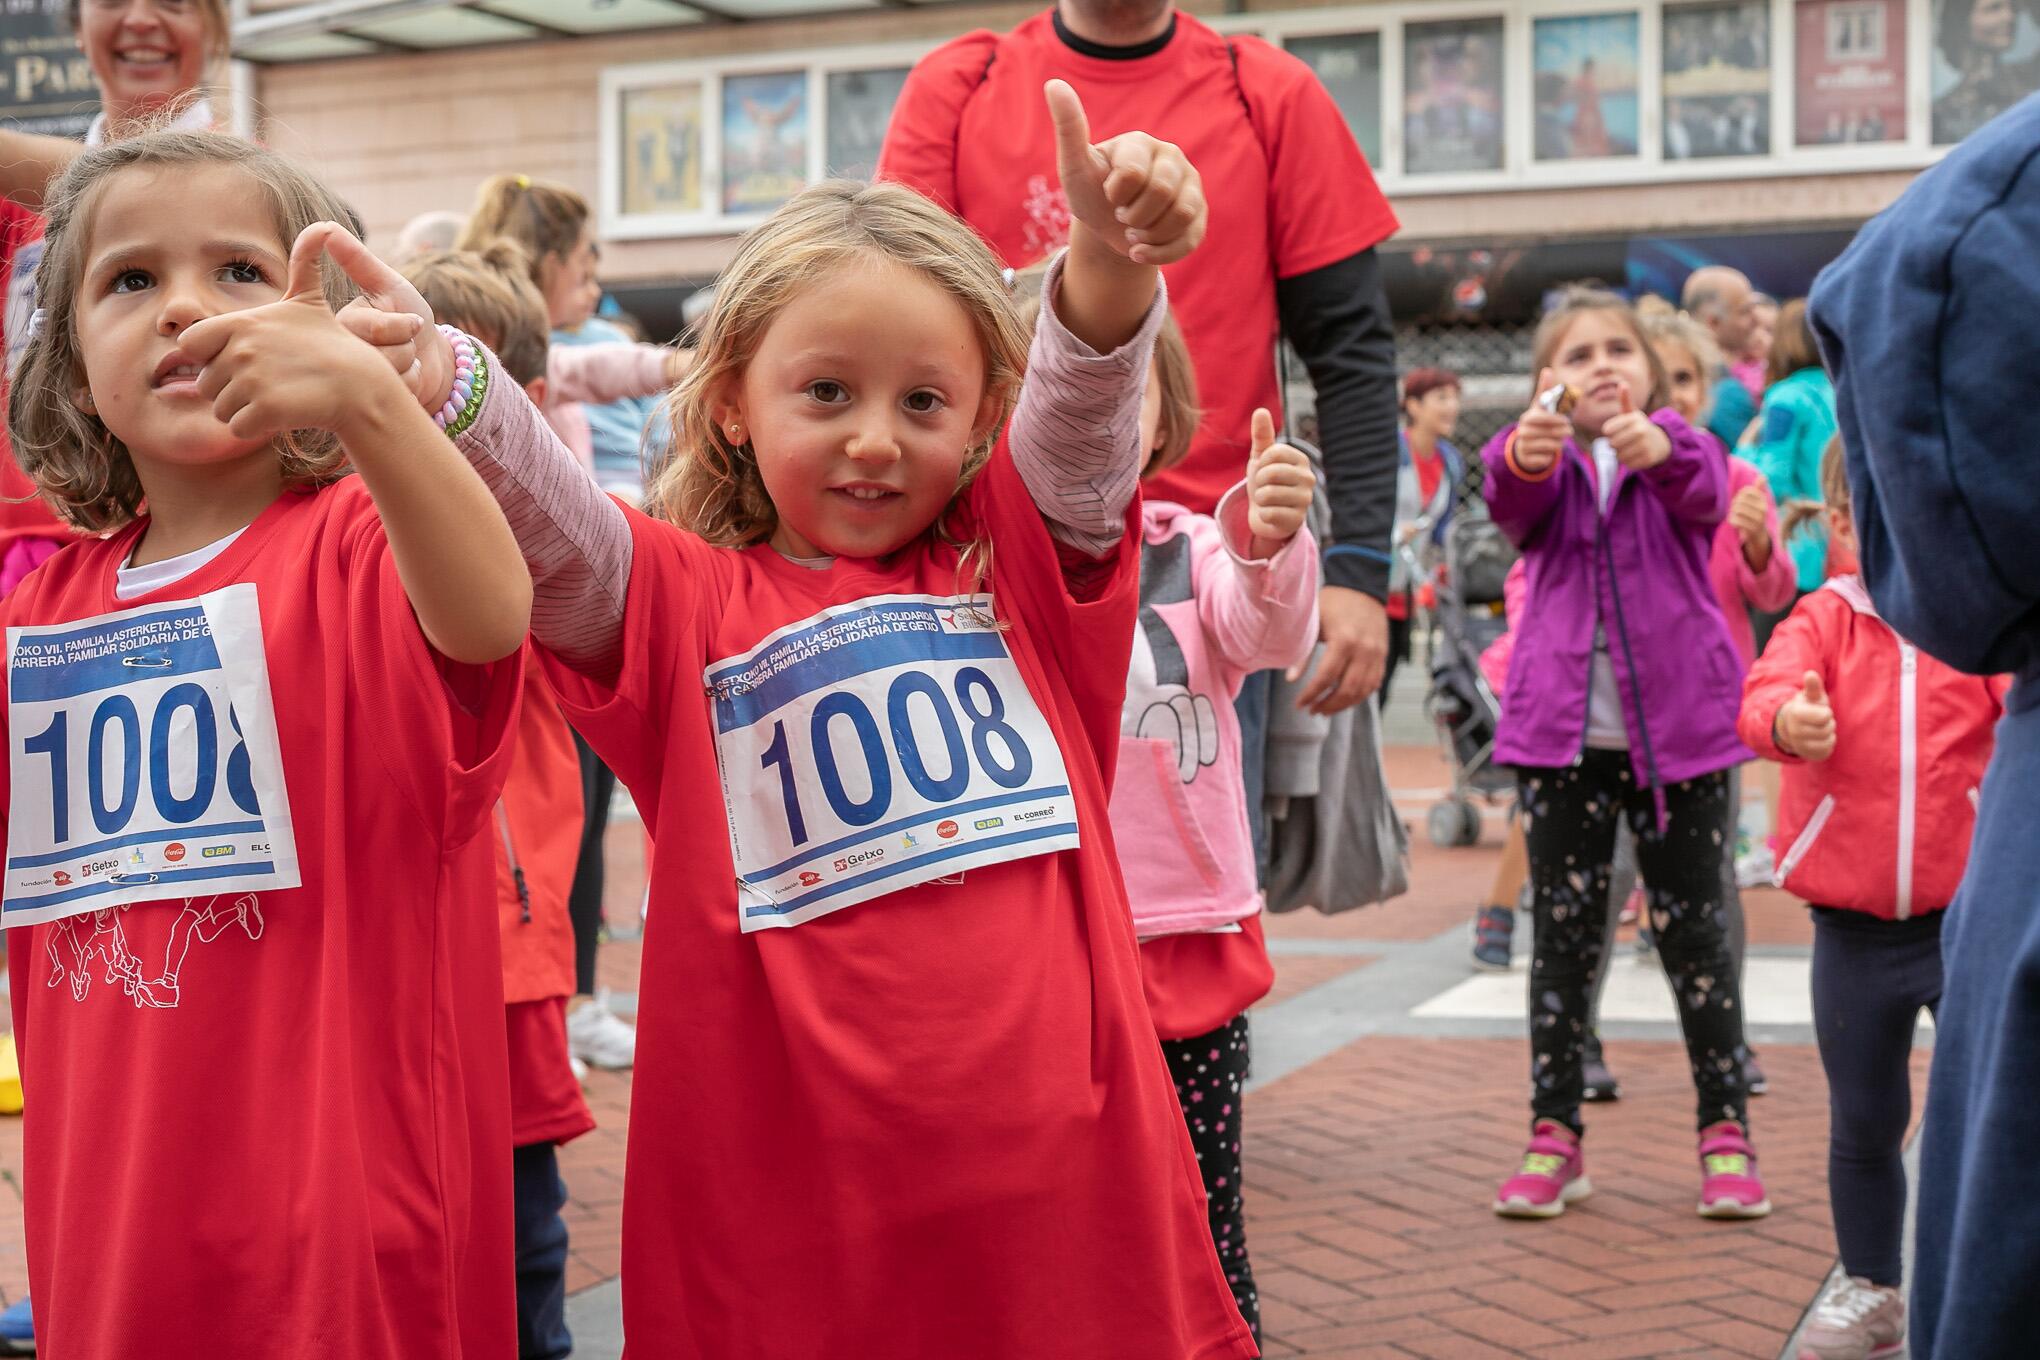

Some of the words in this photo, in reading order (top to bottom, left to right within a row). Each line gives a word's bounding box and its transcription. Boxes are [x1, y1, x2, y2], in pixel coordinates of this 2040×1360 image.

[13, 655, 66, 668] ARRERA
[67, 643, 117, 664] FAMILIAR
[119, 631, 180, 652] SOLIDARIA
[183, 627, 199, 640] DE
[14, 644, 41, 657] OKO
[44, 643, 62, 655] VII.
[65, 635, 105, 652] FAMILIA
[106, 620, 172, 643] LASTERKETA
[174, 615, 208, 630] SOLID
[769, 639, 805, 664] FAMILIA
[806, 614, 881, 646] LASTERKETA
[773, 644, 820, 674] FAMILIAR
[822, 623, 892, 651] SOLIDARIA
[893, 621, 908, 633] DE
[908, 621, 939, 633] GETXO
[761, 667, 1033, 847] 1008
[1013, 813, 1025, 821] EL
[1024, 808, 1054, 820] CORREO
[91, 859, 119, 872] Getxo
[847, 848, 884, 865] Getxo
